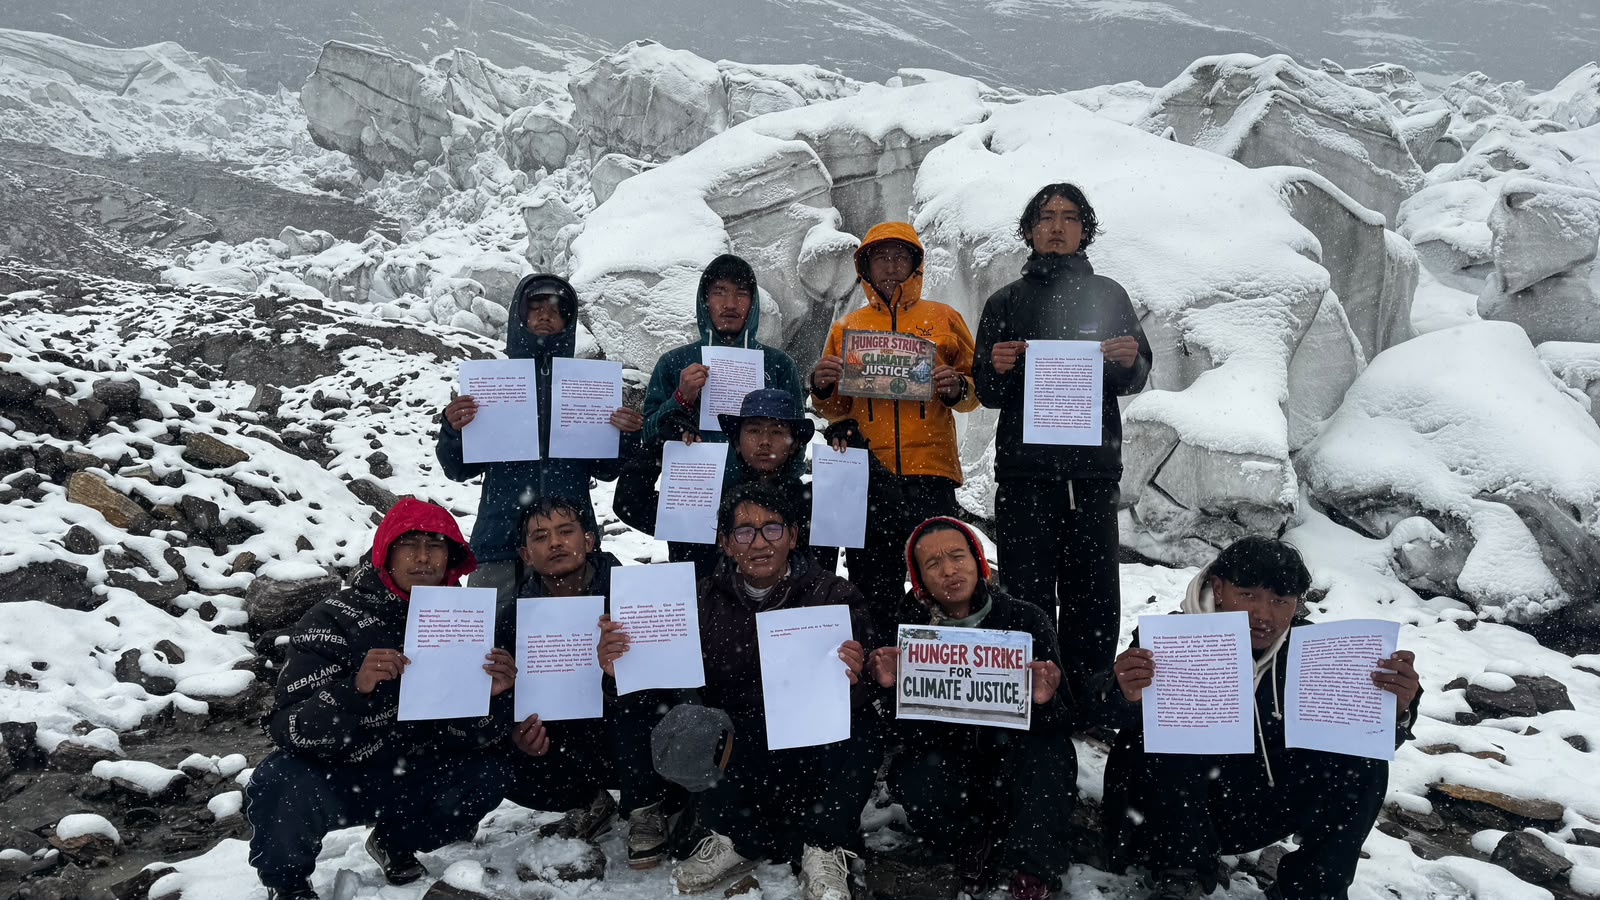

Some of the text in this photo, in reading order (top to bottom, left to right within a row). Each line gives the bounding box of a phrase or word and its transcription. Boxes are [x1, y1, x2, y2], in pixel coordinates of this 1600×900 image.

[852, 336, 927, 354] HUNGER STRIKE
[862, 353, 911, 366] CLIMATE
[862, 365, 909, 377] JUSTICE
[909, 643, 1023, 669] HUNGER STRIKE
[950, 667, 971, 678] FOR
[311, 676, 333, 690] PARIS
[903, 676, 1019, 704] CLIMATE JUSTICE
